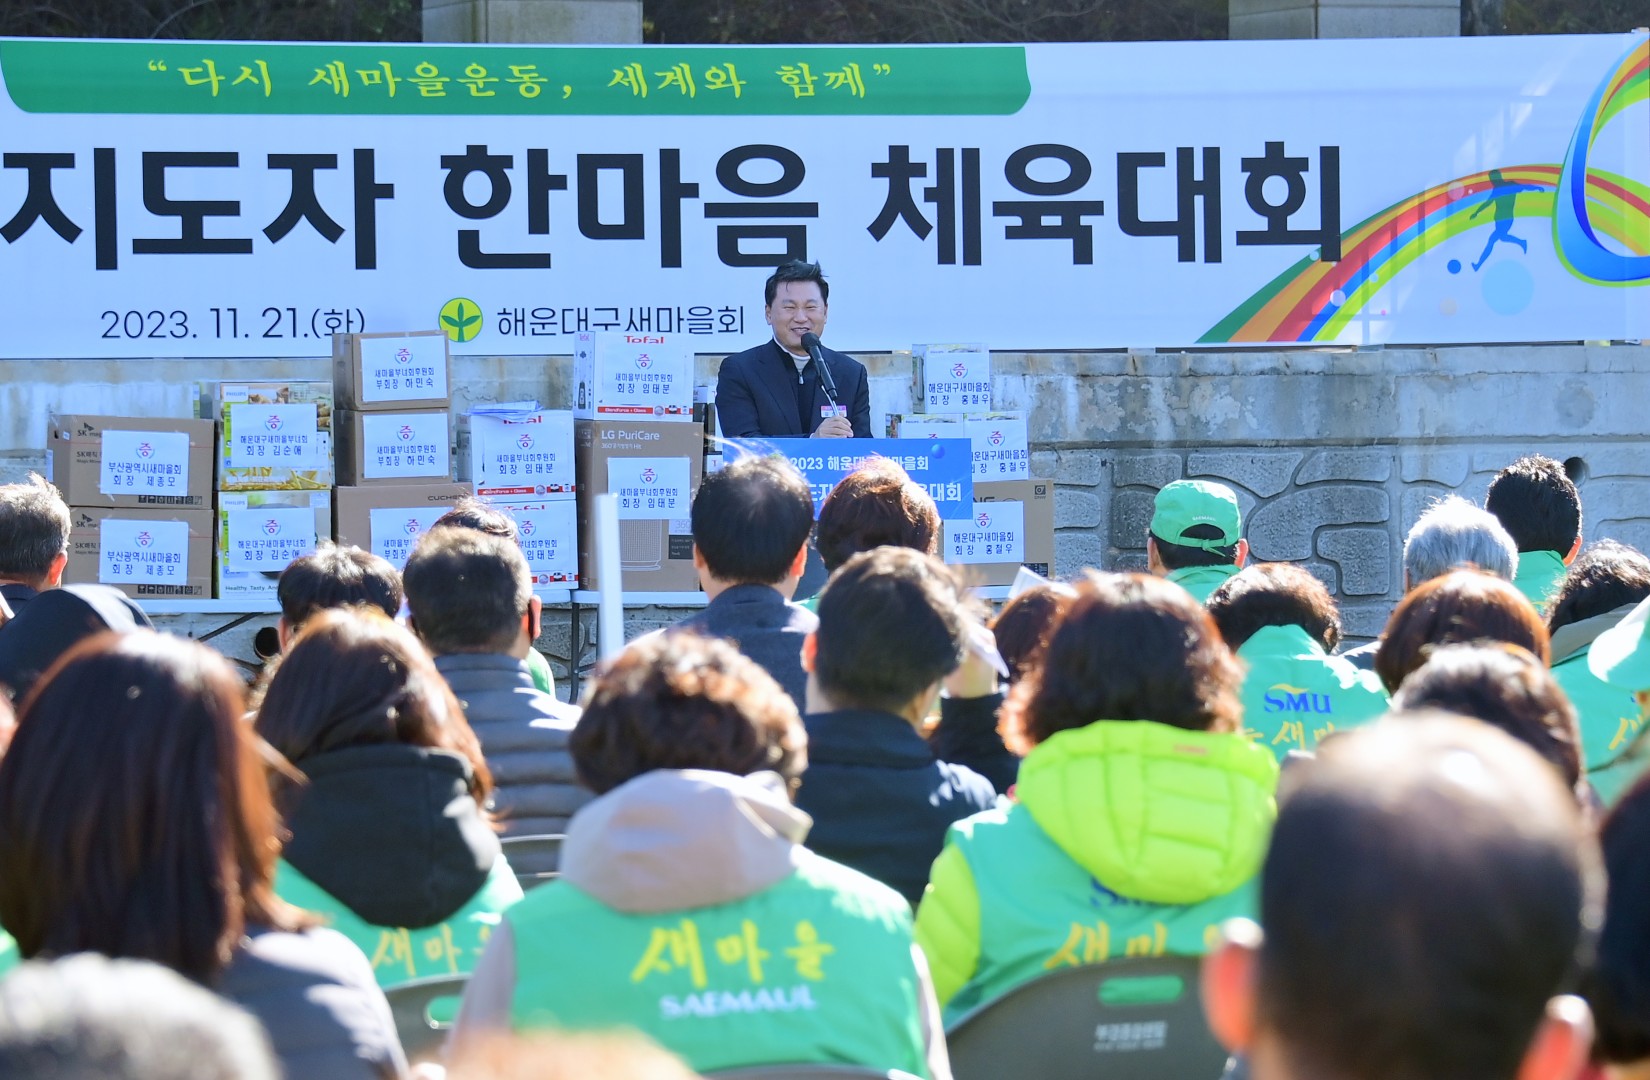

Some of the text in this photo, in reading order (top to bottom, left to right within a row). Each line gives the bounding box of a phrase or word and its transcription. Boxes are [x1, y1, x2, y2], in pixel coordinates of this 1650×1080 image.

[308, 60, 572, 99] 새마을운동,
[607, 63, 747, 99] 세계와
[775, 63, 891, 98] 함께”
[0, 141, 1342, 271] 지도자 한마음 체육대회
[101, 310, 198, 339] 2023.
[209, 307, 249, 339] 11.
[497, 305, 745, 336] 해운대구새마을회
[405, 377, 434, 389] 하민숙
[928, 382, 990, 394] 해운대구새마을회
[601, 430, 615, 439] LG
[618, 430, 660, 440] PuriCare
[407, 455, 435, 466] 하민숙
[790, 456, 824, 470] 2023
[108, 462, 182, 475] 부산광역시새마을회
[953, 531, 1014, 543] 해운대구새마을회
[107, 551, 181, 564] 부산광역시새마을회
[1264, 691, 1332, 714] SMU
[630, 918, 836, 990] 새마을
